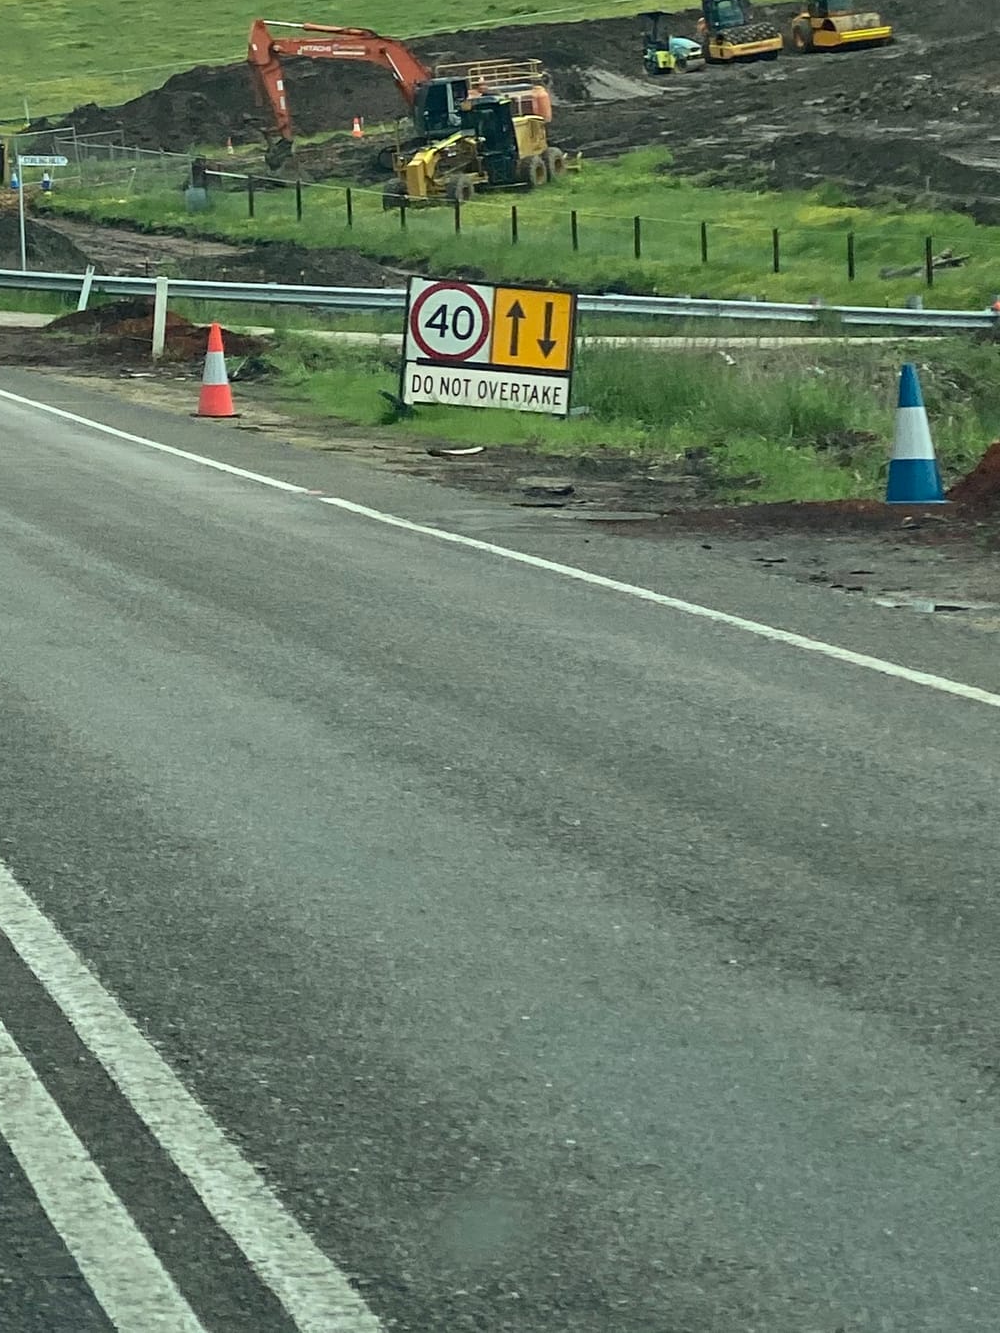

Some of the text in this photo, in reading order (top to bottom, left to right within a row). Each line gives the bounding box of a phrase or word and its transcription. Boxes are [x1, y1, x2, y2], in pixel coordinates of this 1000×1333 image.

[424, 304, 475, 341] 40
[412, 374, 562, 405] DO NOT OVERTAKE
